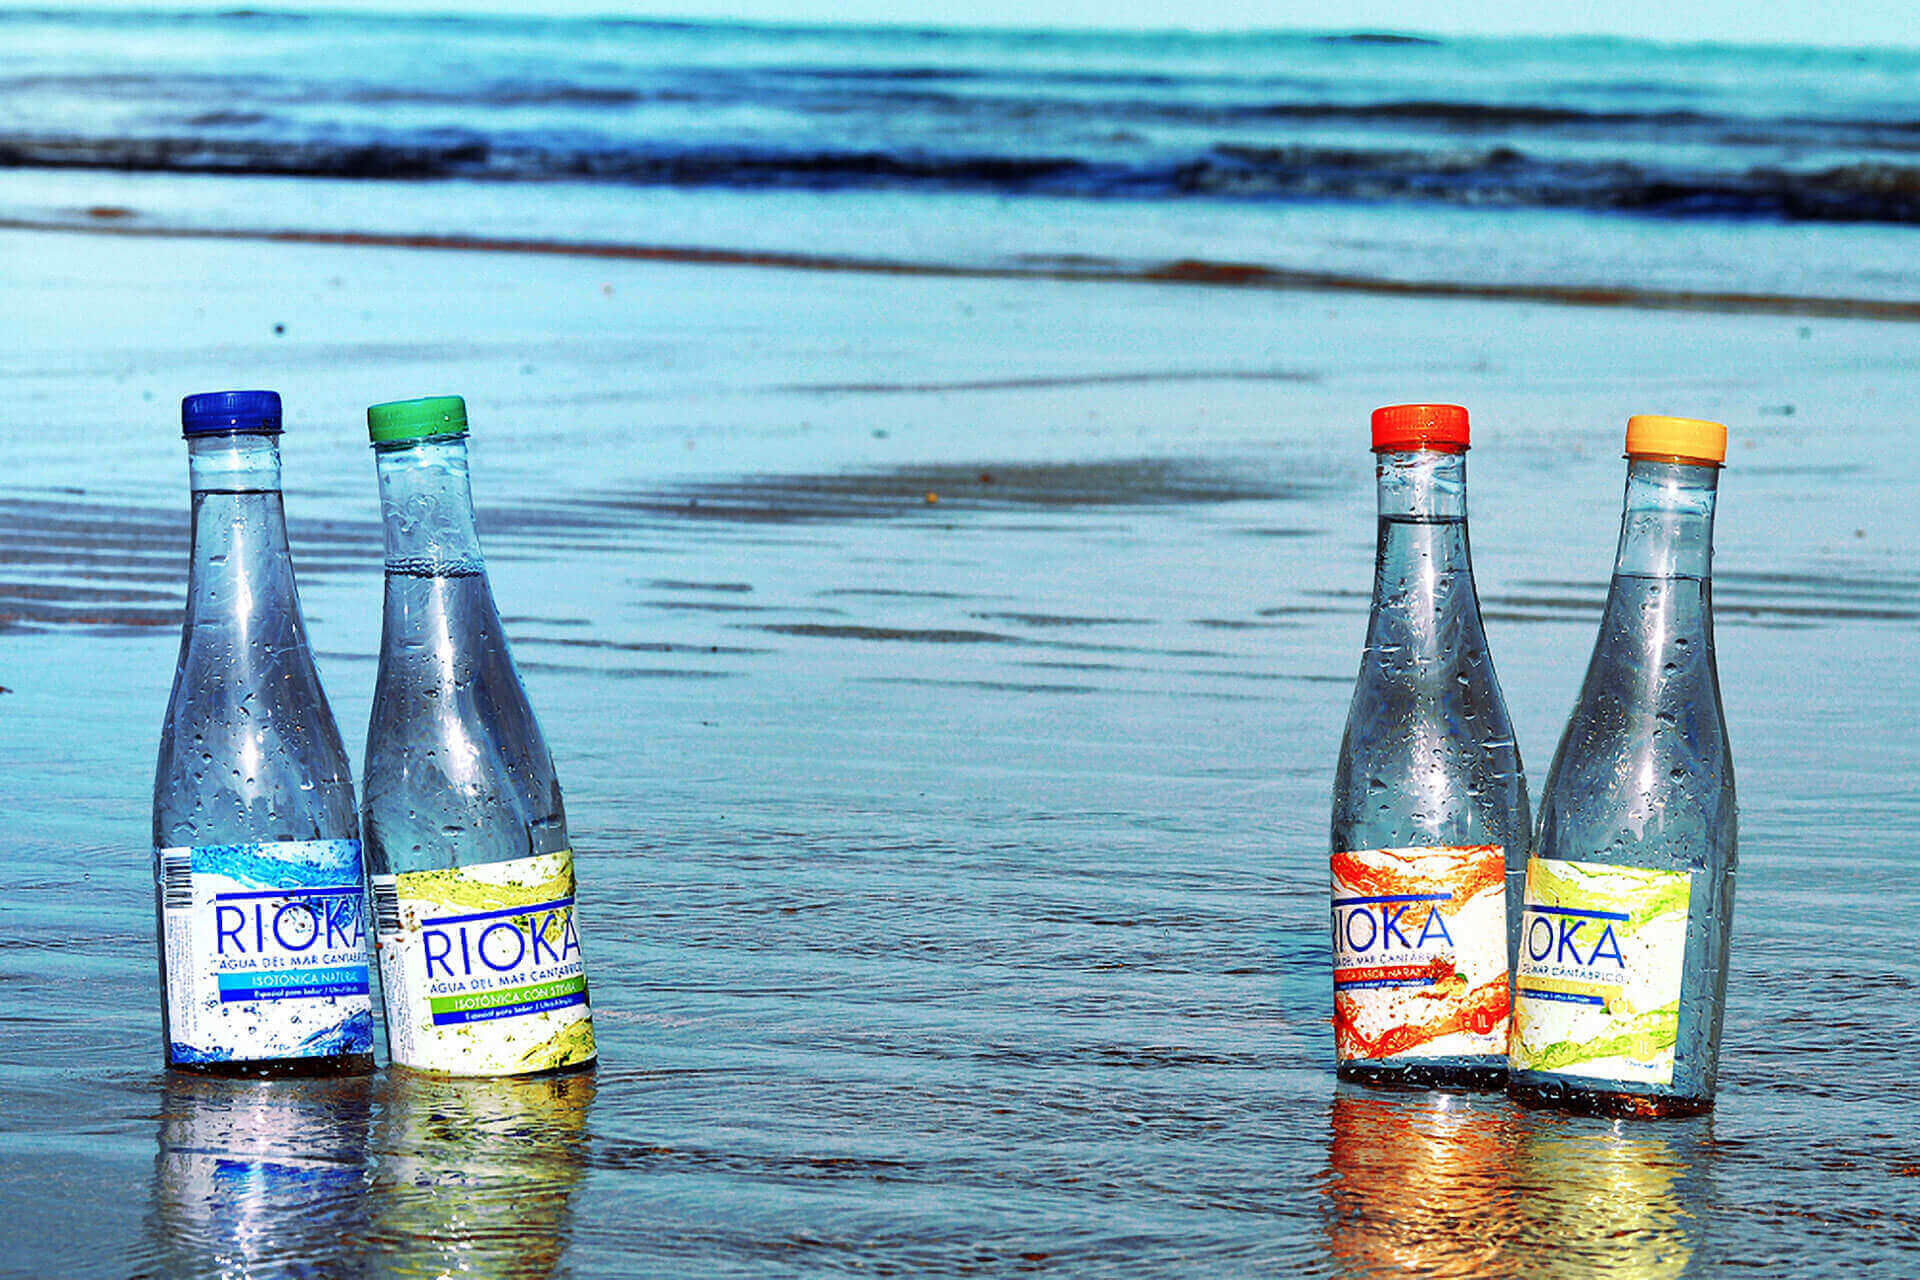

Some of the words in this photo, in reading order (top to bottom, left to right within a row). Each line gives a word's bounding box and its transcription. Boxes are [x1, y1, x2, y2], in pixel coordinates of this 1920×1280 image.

[423, 912, 581, 979] RIOKA
[262, 957, 285, 969] DEL
[290, 955, 318, 966] MAR
[471, 978, 494, 990] DEL
[500, 972, 526, 985] MAR
